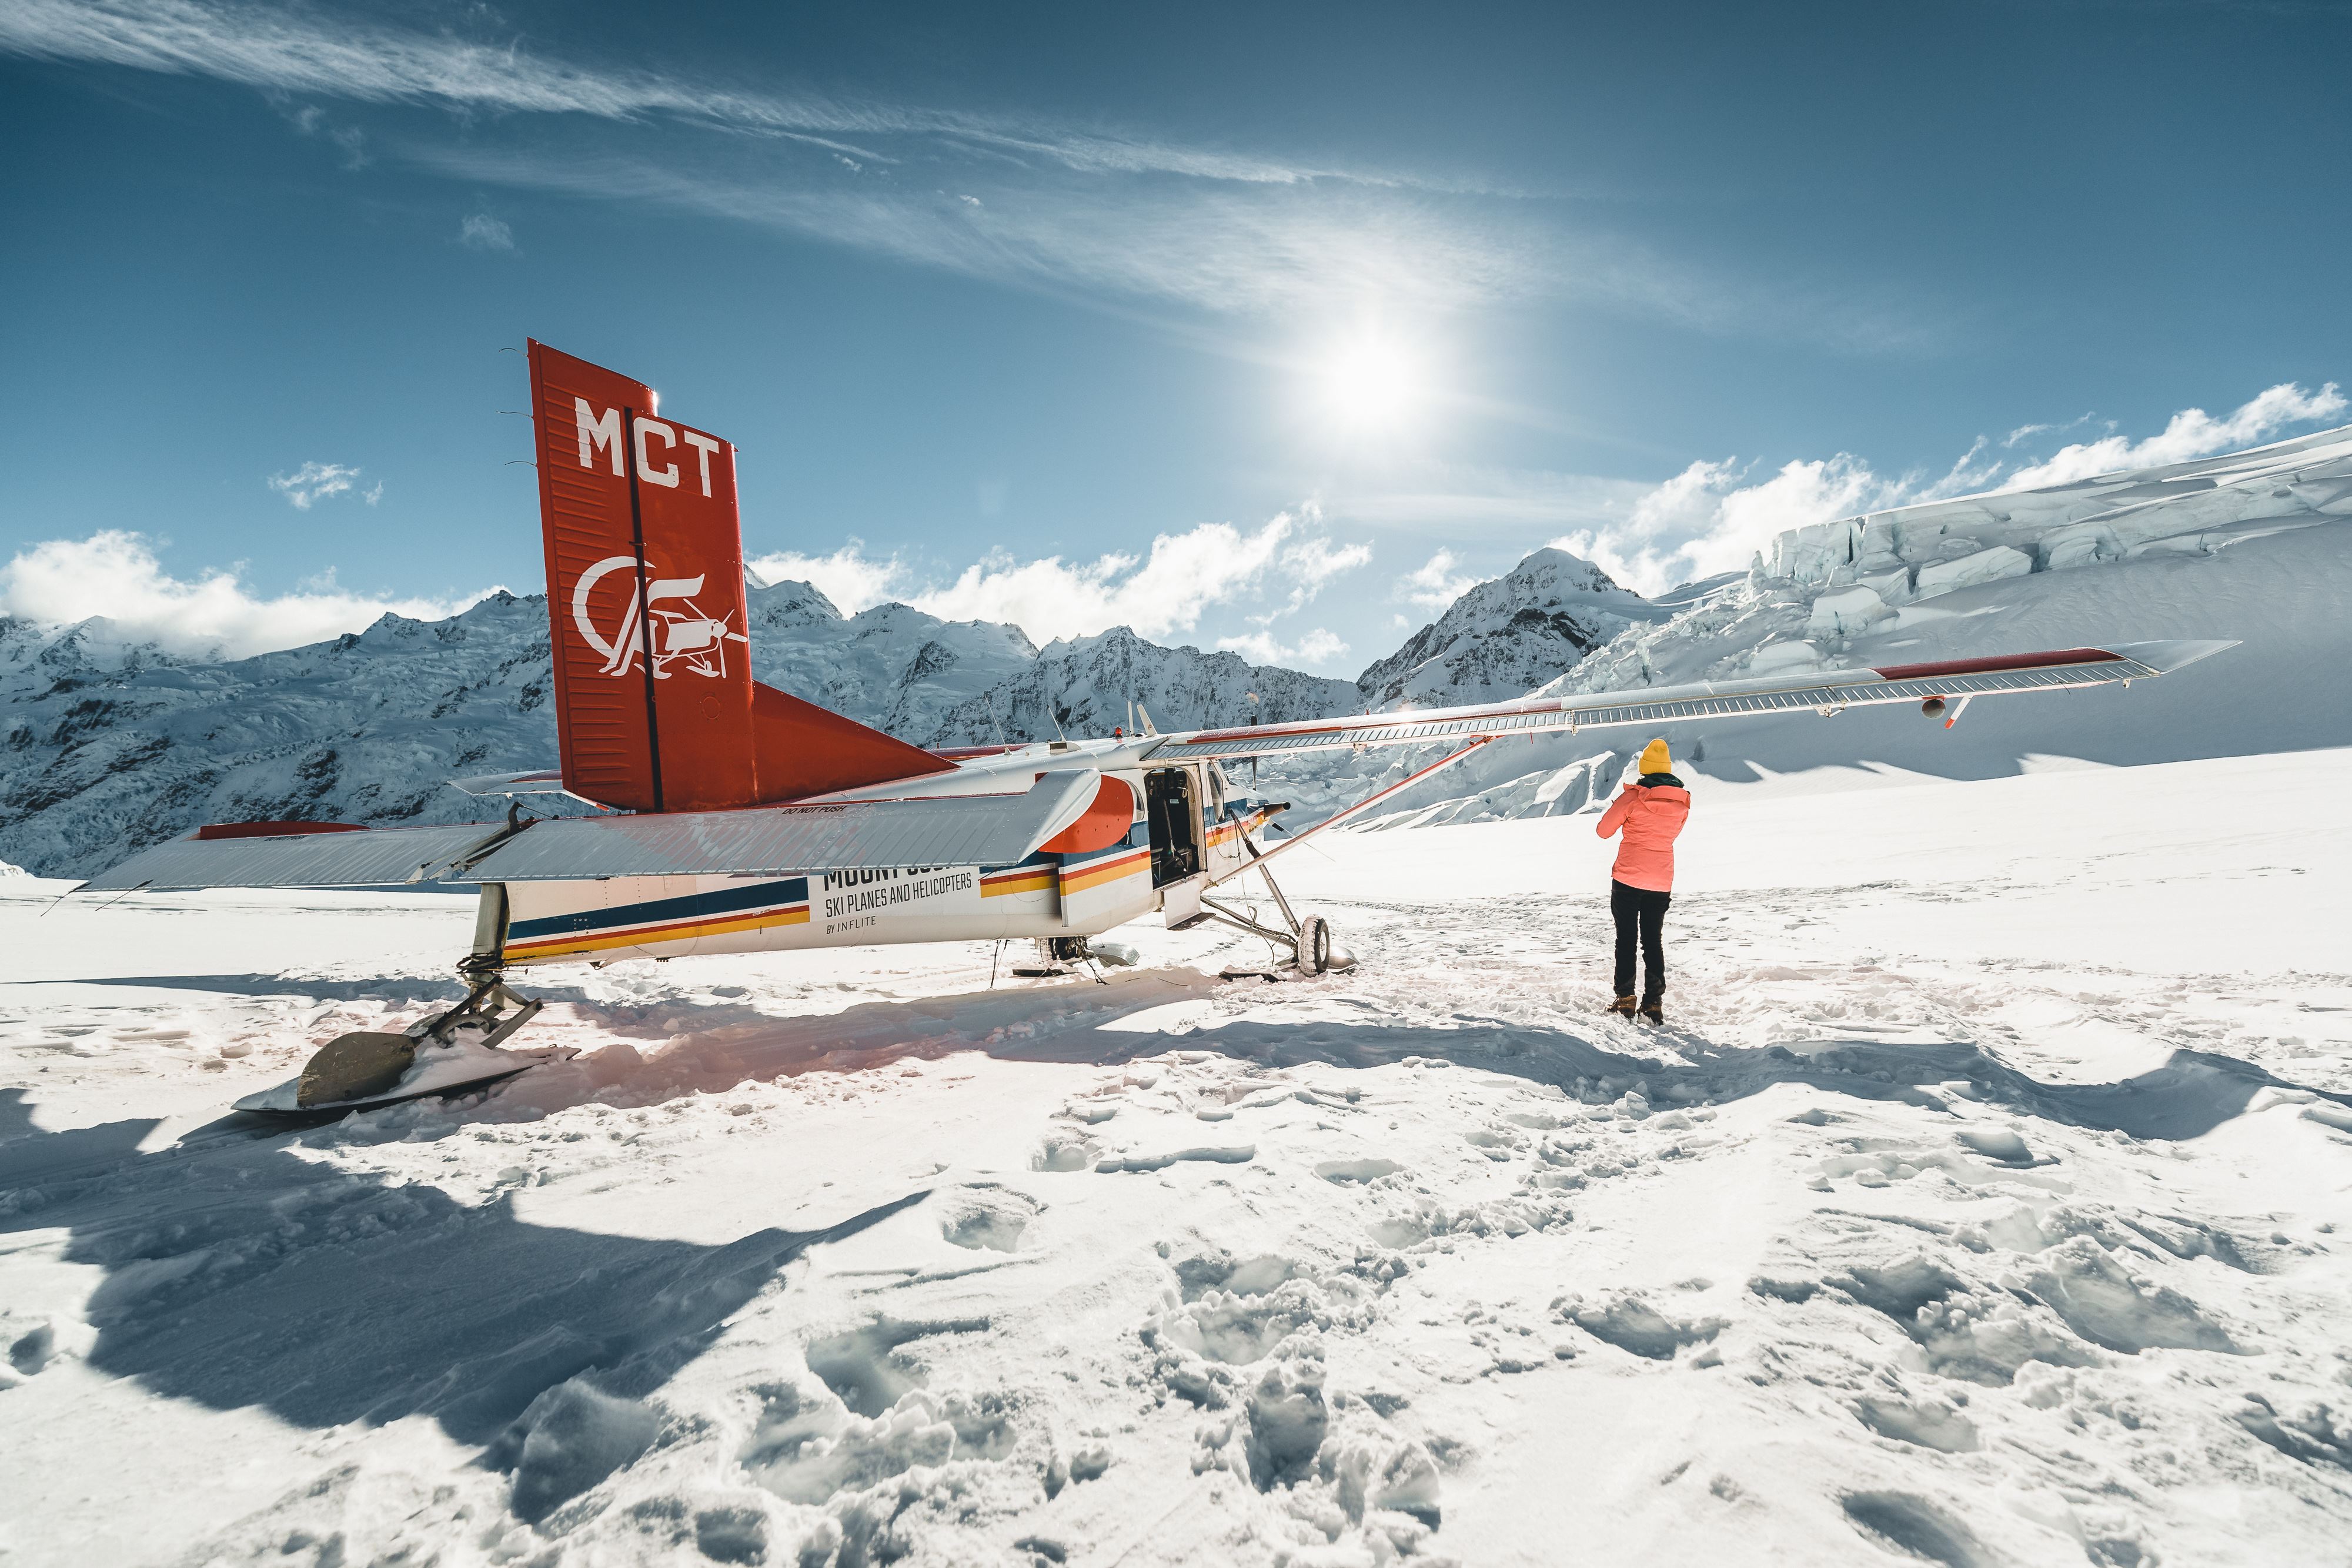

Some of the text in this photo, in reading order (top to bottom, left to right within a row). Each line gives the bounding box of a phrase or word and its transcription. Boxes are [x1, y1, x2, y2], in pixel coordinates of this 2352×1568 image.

[574, 397, 719, 498] MCT
[826, 872, 971, 917] SKI PLANES AND HELICOPTERS
[826, 916, 876, 934] BY INFLITE
